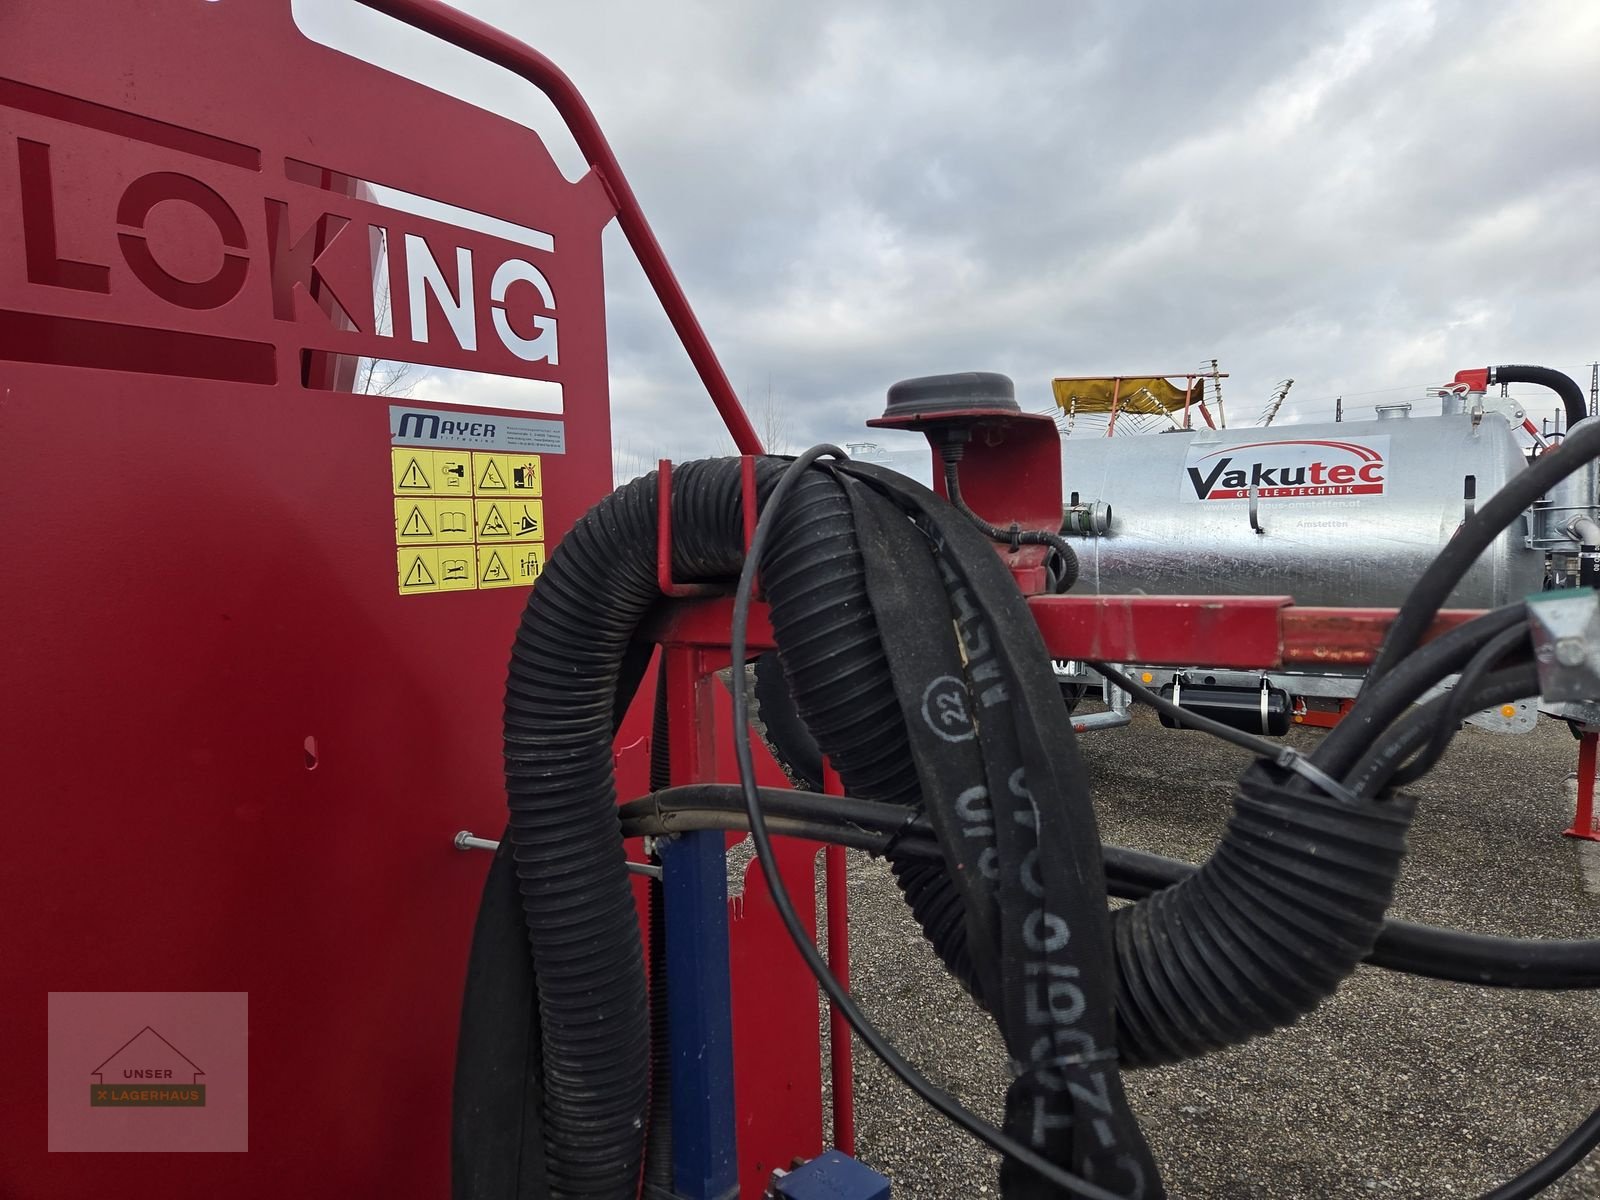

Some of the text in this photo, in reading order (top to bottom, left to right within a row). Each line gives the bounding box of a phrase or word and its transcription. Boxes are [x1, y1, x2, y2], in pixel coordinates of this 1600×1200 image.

[17, 136, 560, 365] LOKING
[398, 413, 496, 439] MAYER
[1187, 457, 1384, 500] Vakutec
[1296, 520, 1348, 528] Amstetten
[936, 691, 969, 726] 22
